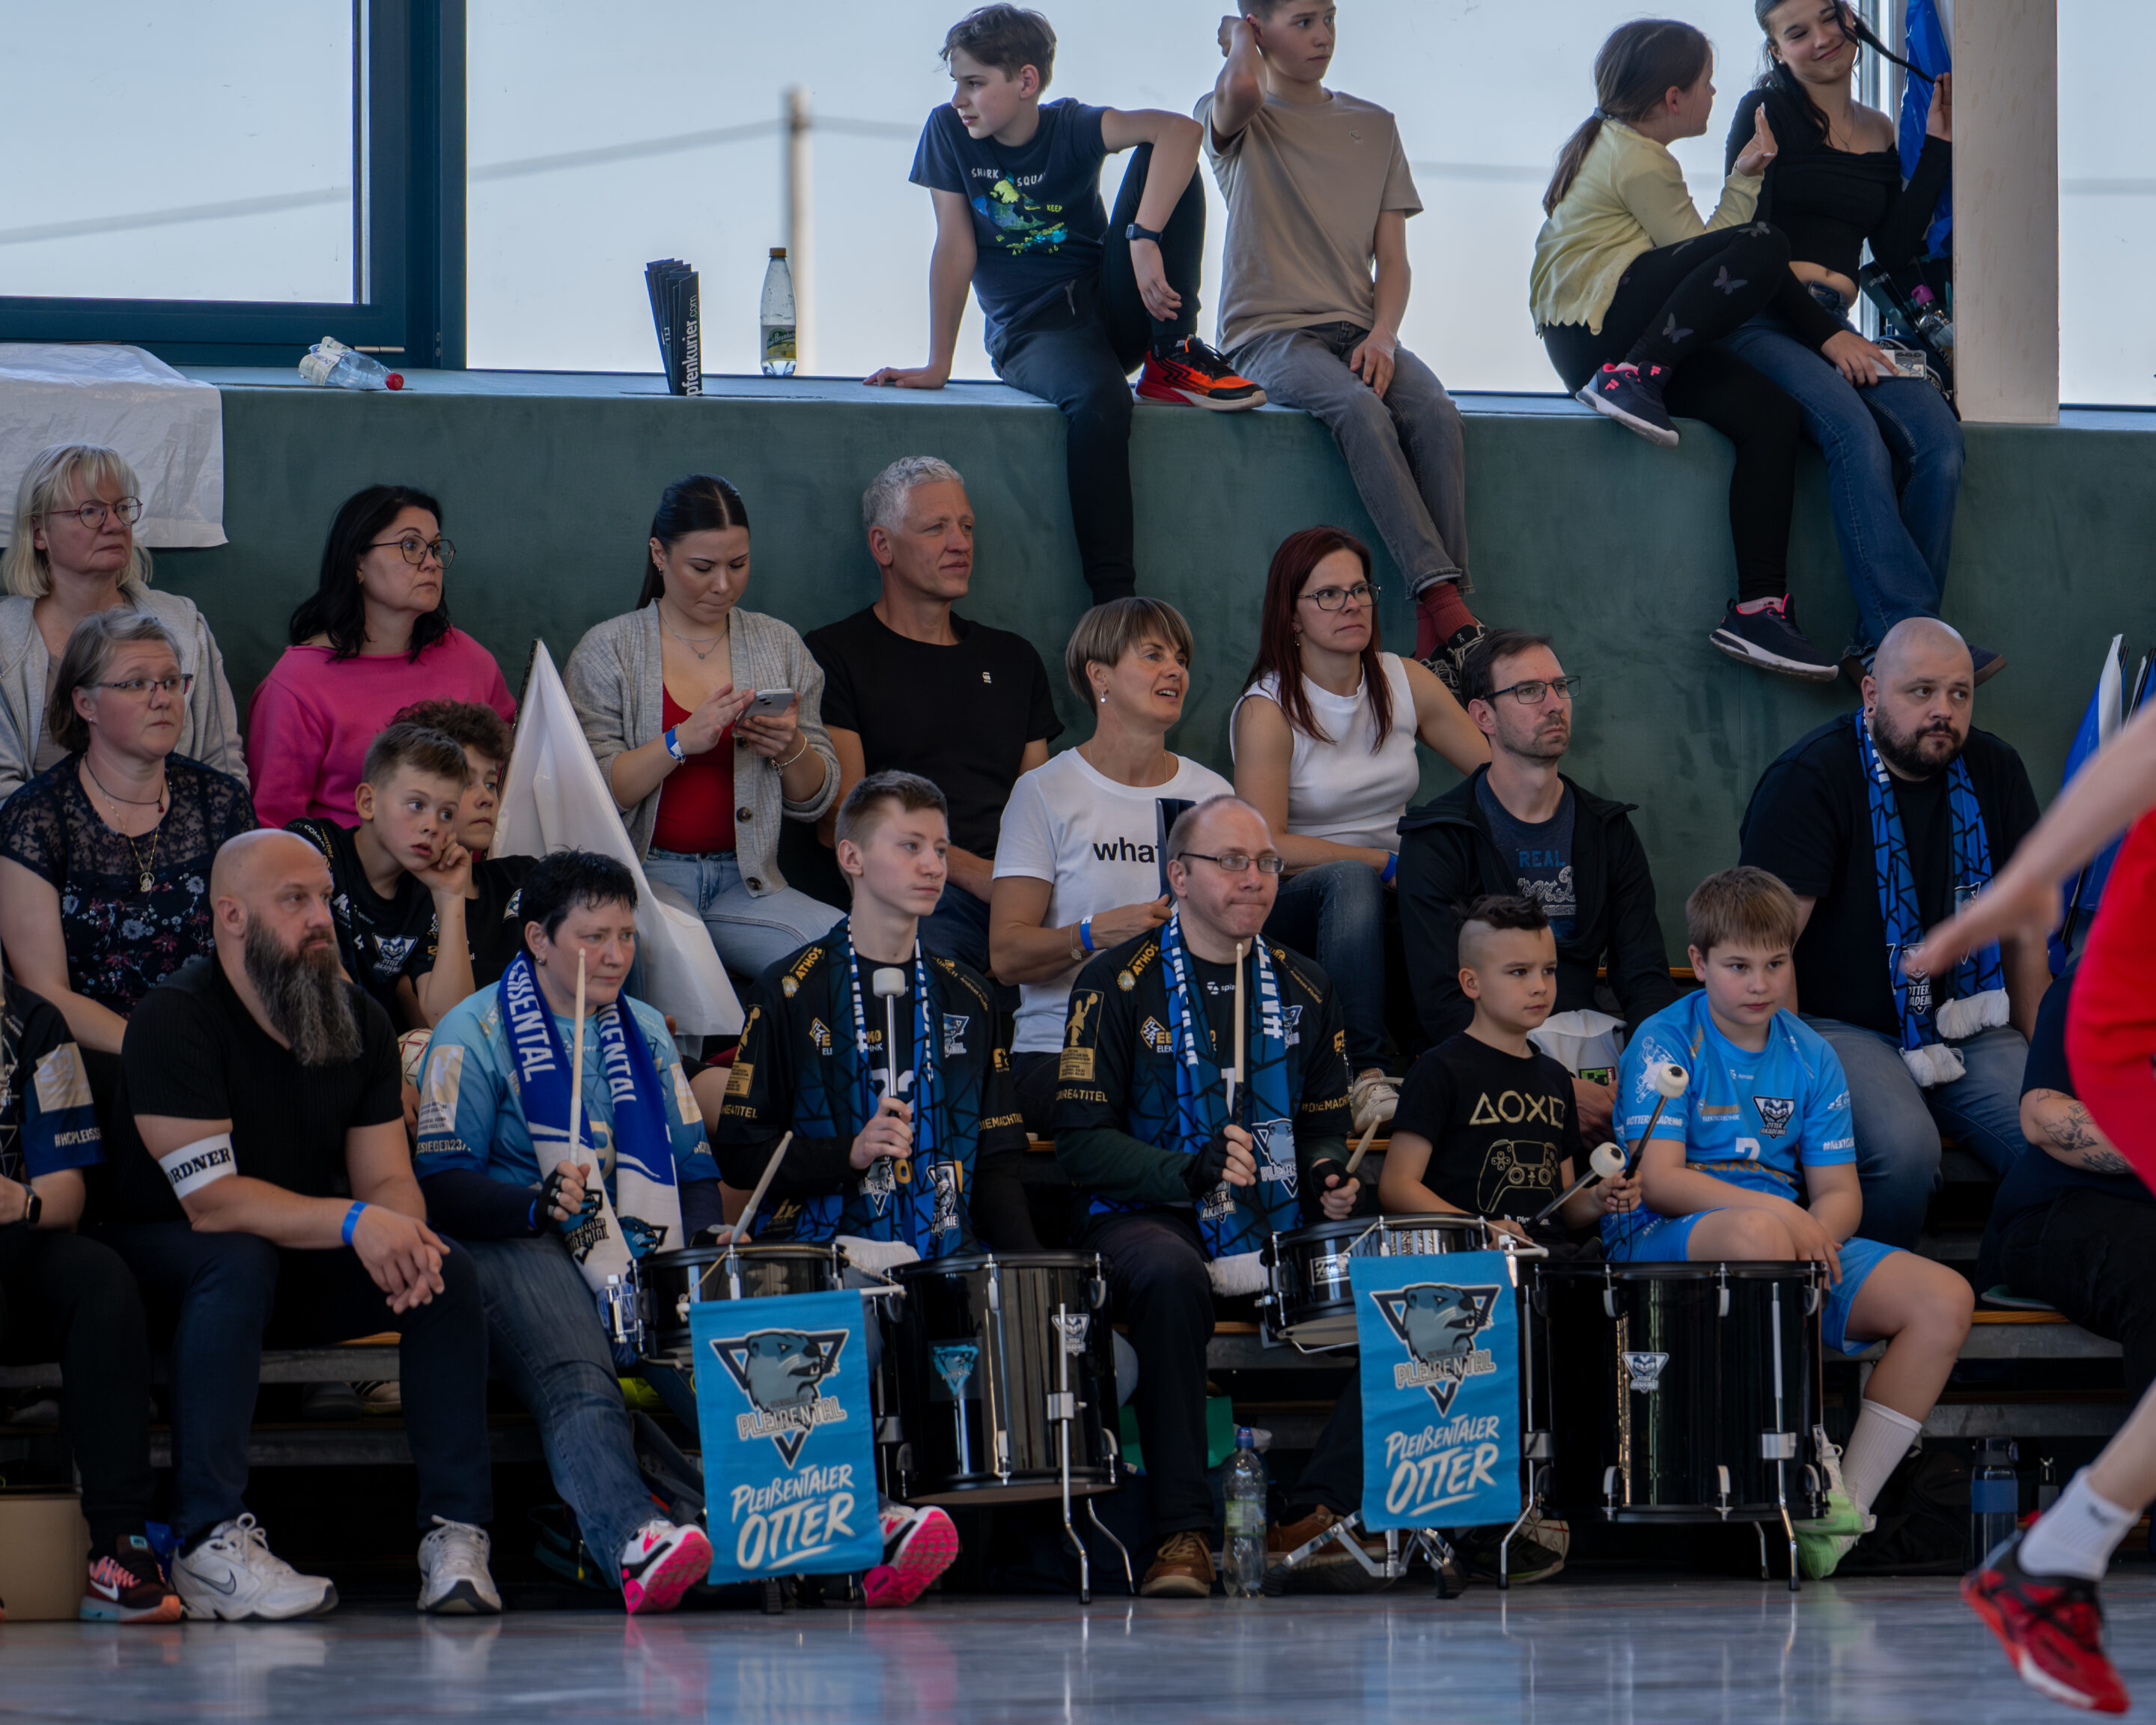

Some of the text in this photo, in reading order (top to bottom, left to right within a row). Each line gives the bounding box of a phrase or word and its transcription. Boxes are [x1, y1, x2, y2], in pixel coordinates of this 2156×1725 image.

[1093, 837, 1158, 863] wha
[1519, 851, 1566, 868] REAL
[795, 946, 823, 980] ATHOS
[1301, 1093, 1350, 1113] #DIEMACH
[1386, 1442, 1498, 1515] OTTER
[736, 1491, 856, 1570] OTTER
